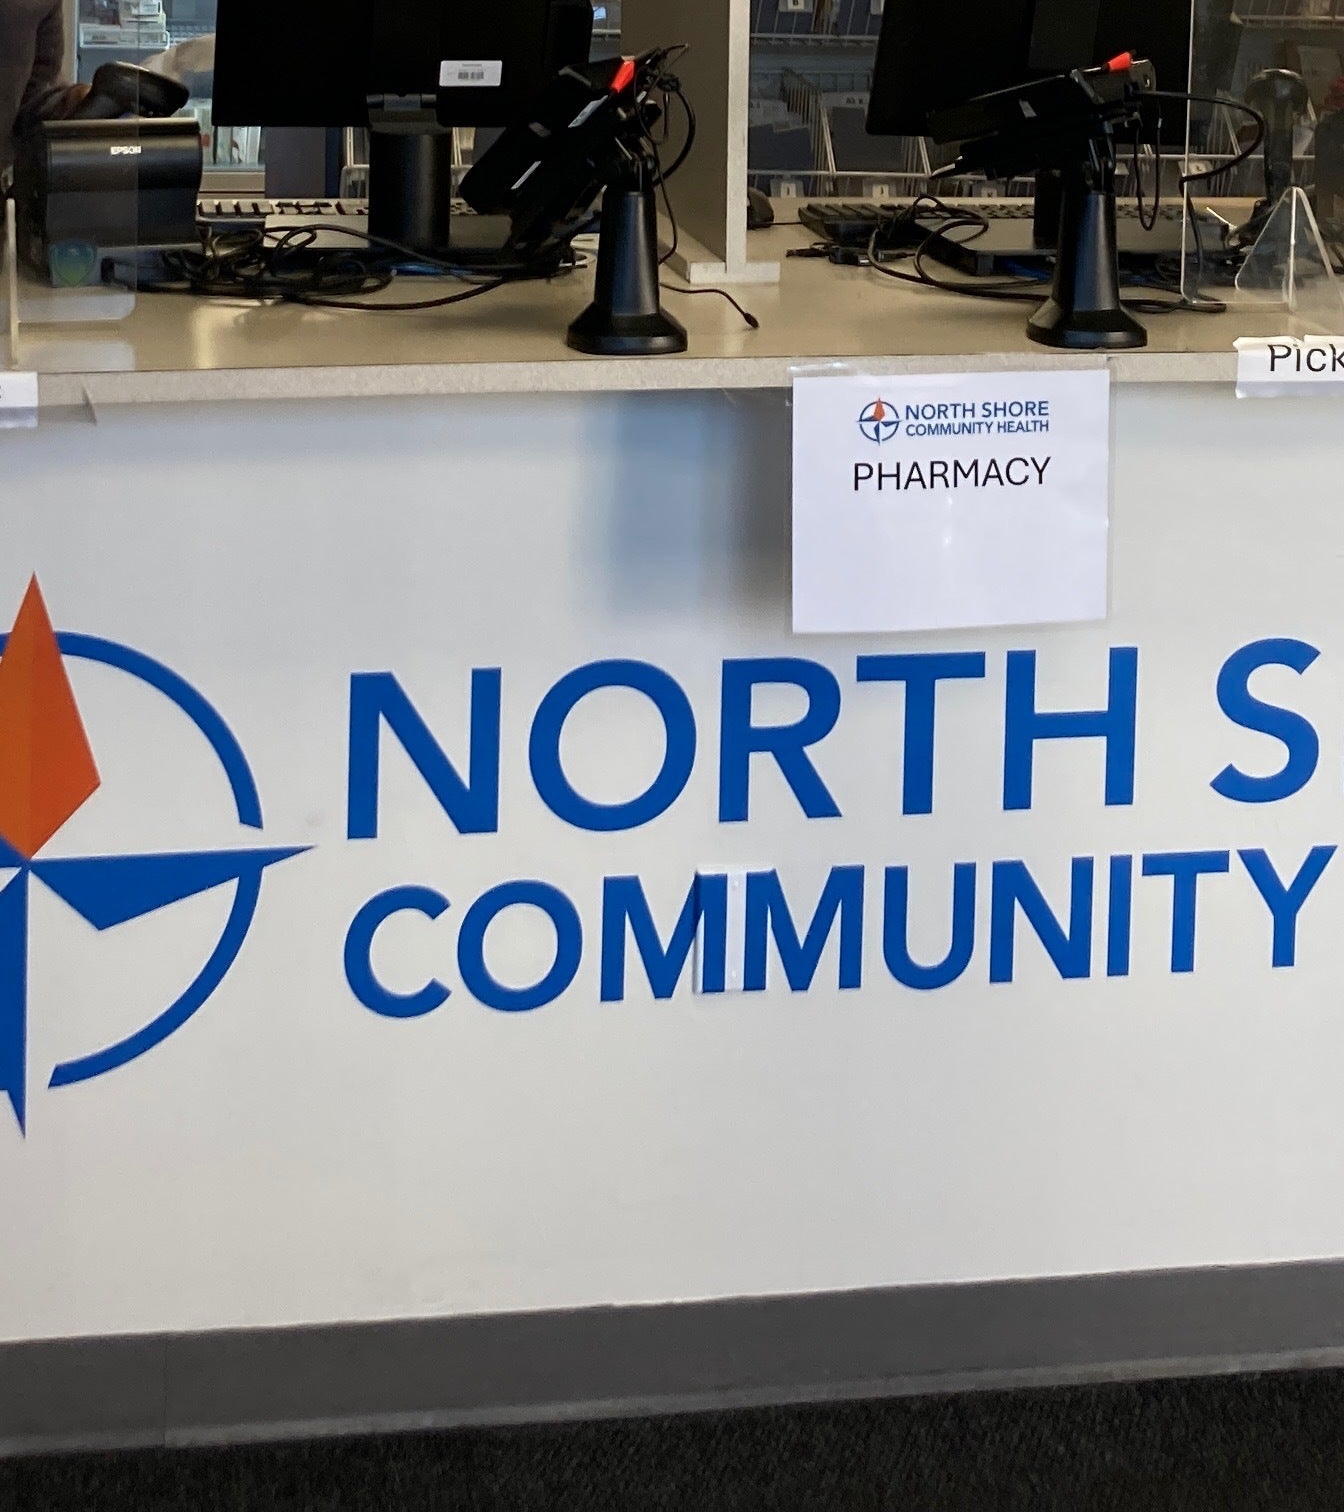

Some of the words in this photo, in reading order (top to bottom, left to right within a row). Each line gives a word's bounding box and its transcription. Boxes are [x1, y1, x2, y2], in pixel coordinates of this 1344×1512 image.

[905, 402, 977, 421] NORTH
[981, 400, 1050, 418] SHORE
[905, 420, 994, 437] COMMUNITY
[997, 419, 1050, 434] HEALTH
[853, 455, 1052, 492] PHARMACY
[345, 644, 1140, 841] NORTH
[342, 843, 1338, 1020] COMMUNITY
